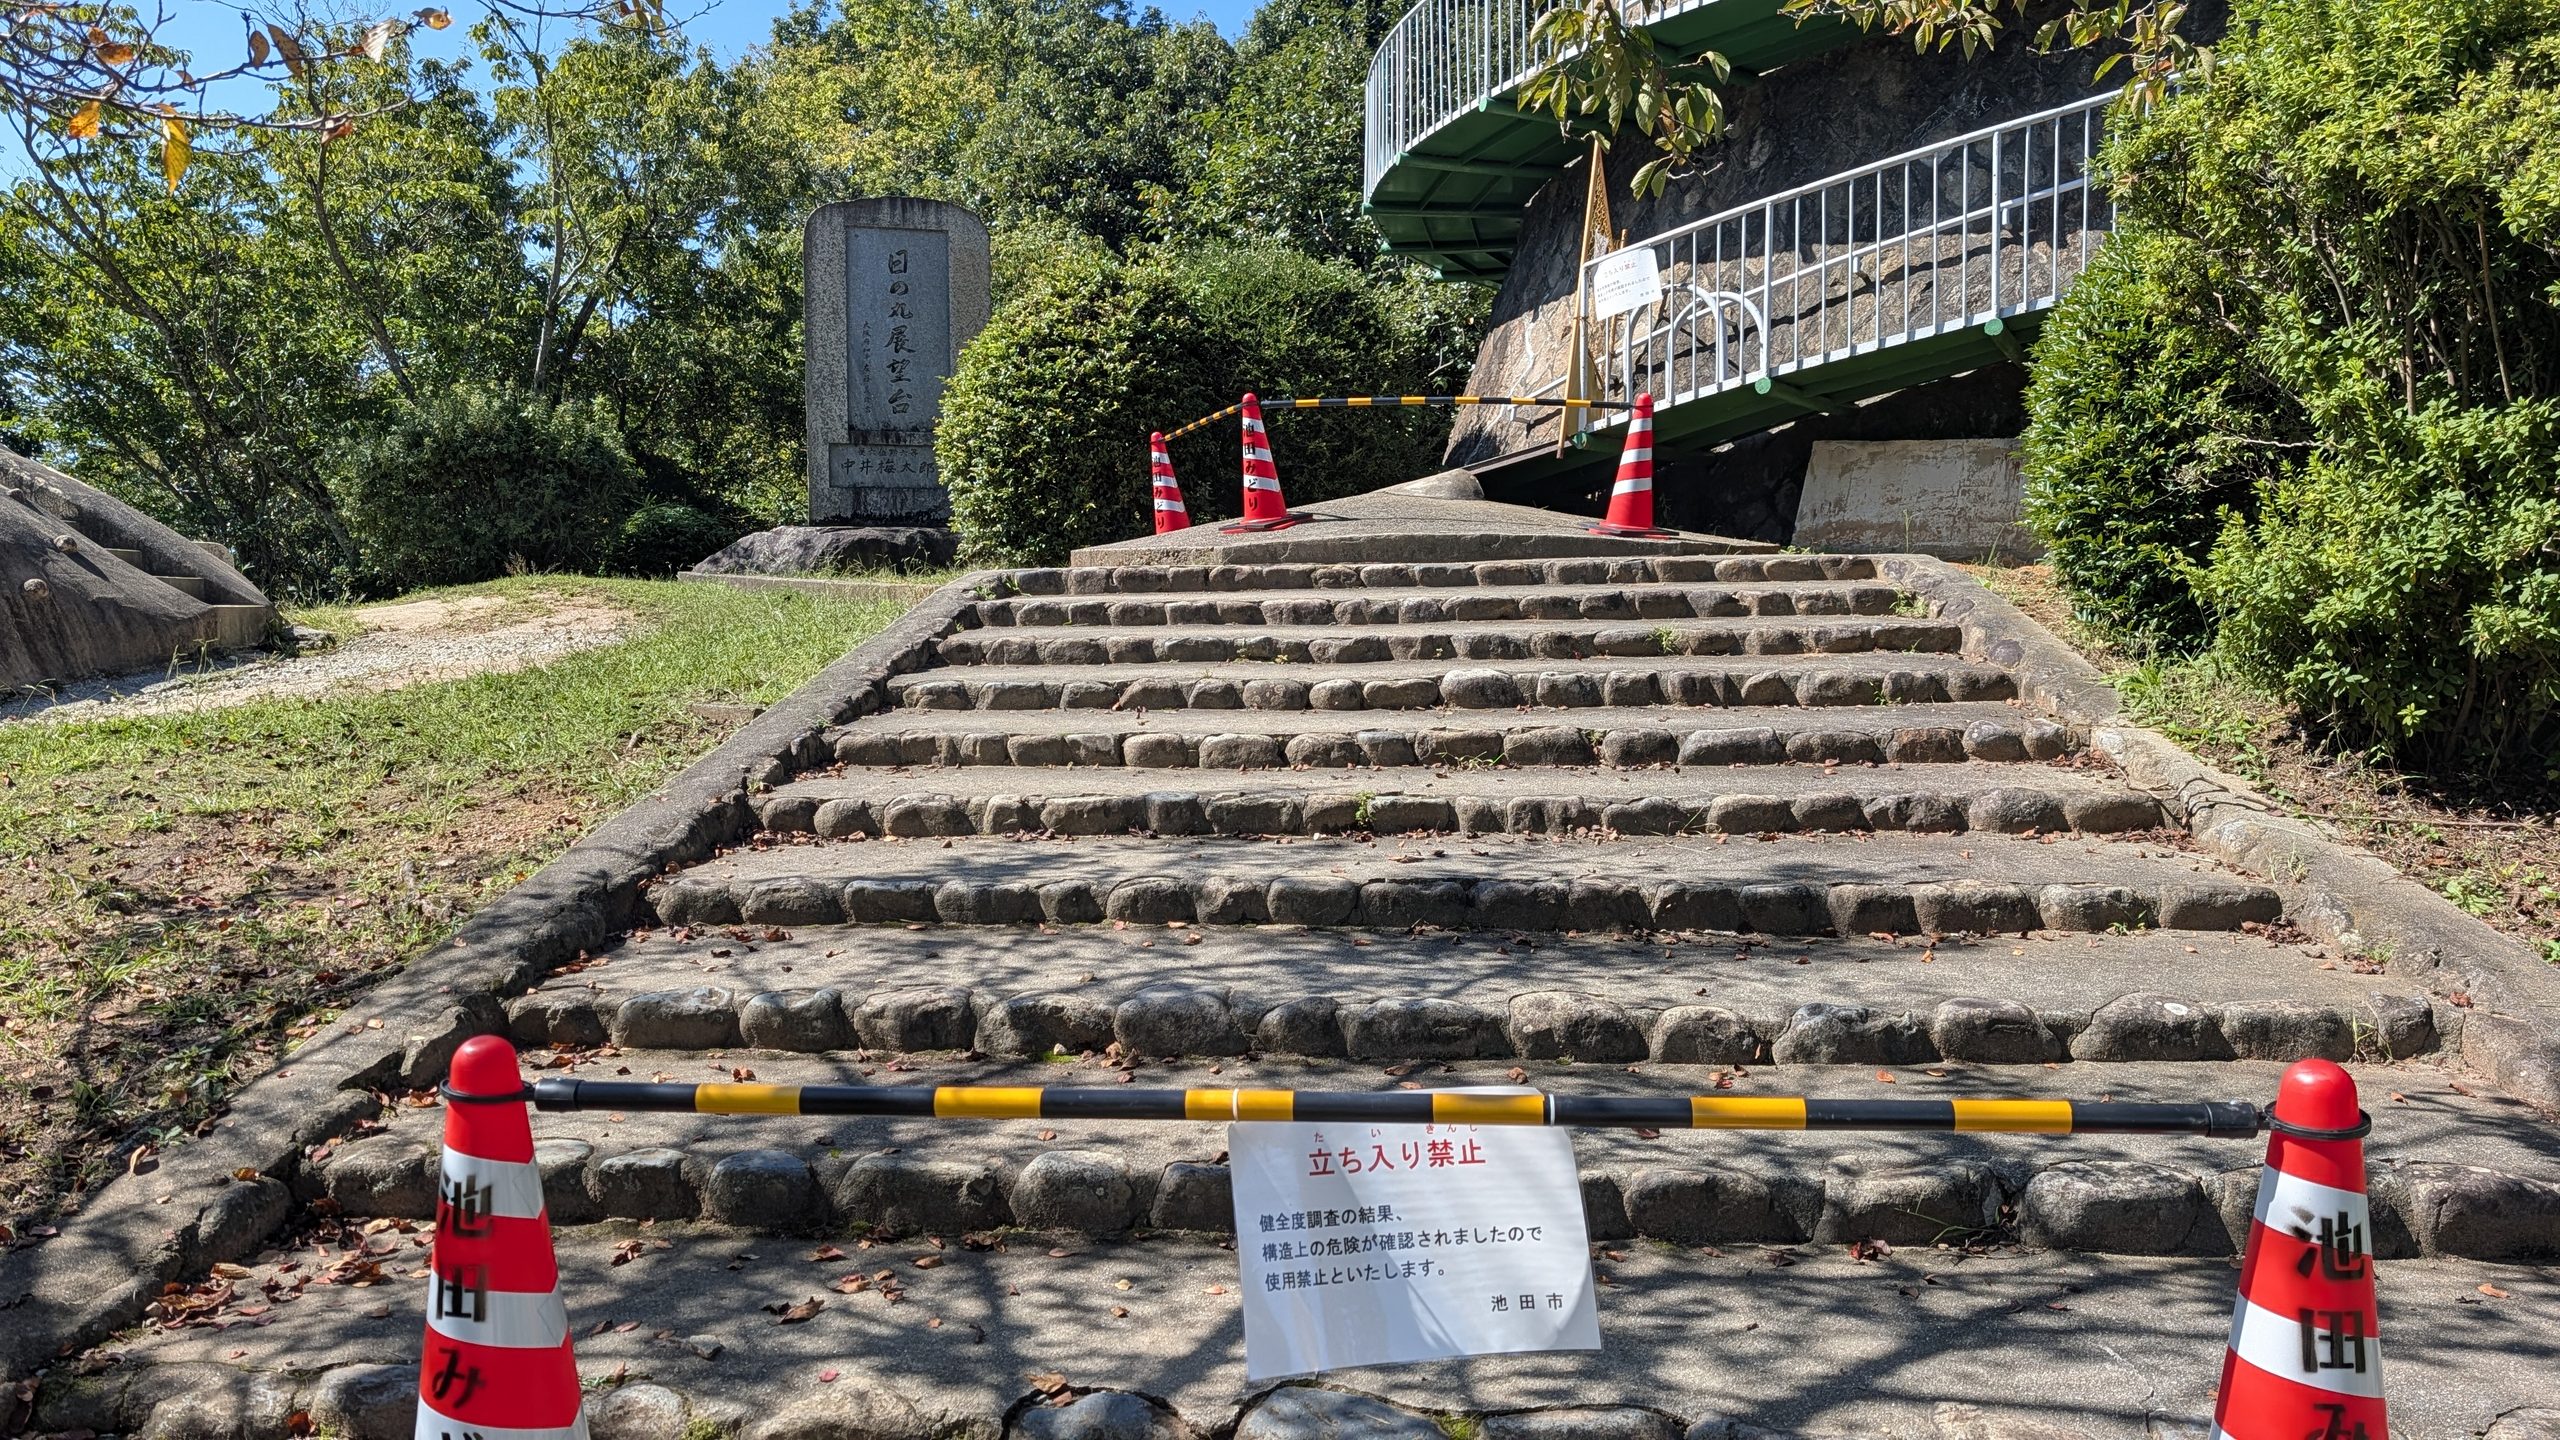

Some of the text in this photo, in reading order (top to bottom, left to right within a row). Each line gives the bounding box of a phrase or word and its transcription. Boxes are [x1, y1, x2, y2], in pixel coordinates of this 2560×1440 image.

[884, 250, 916, 414] 日の丸展望台
[840, 458, 936, 478] 中井梅太郎
[1314, 1132, 1324, 1143] た
[1371, 1128, 1381, 1138] い
[1309, 1138, 1486, 1176] 立ち入り禁止
[1259, 1204, 1403, 1233] 健全度調査の結果、
[1262, 1225, 1542, 1262] 構造上の危険が確認されましたので
[1265, 1258, 1446, 1292] 使用禁止といたします。
[432, 1174, 494, 1440] 池田み
